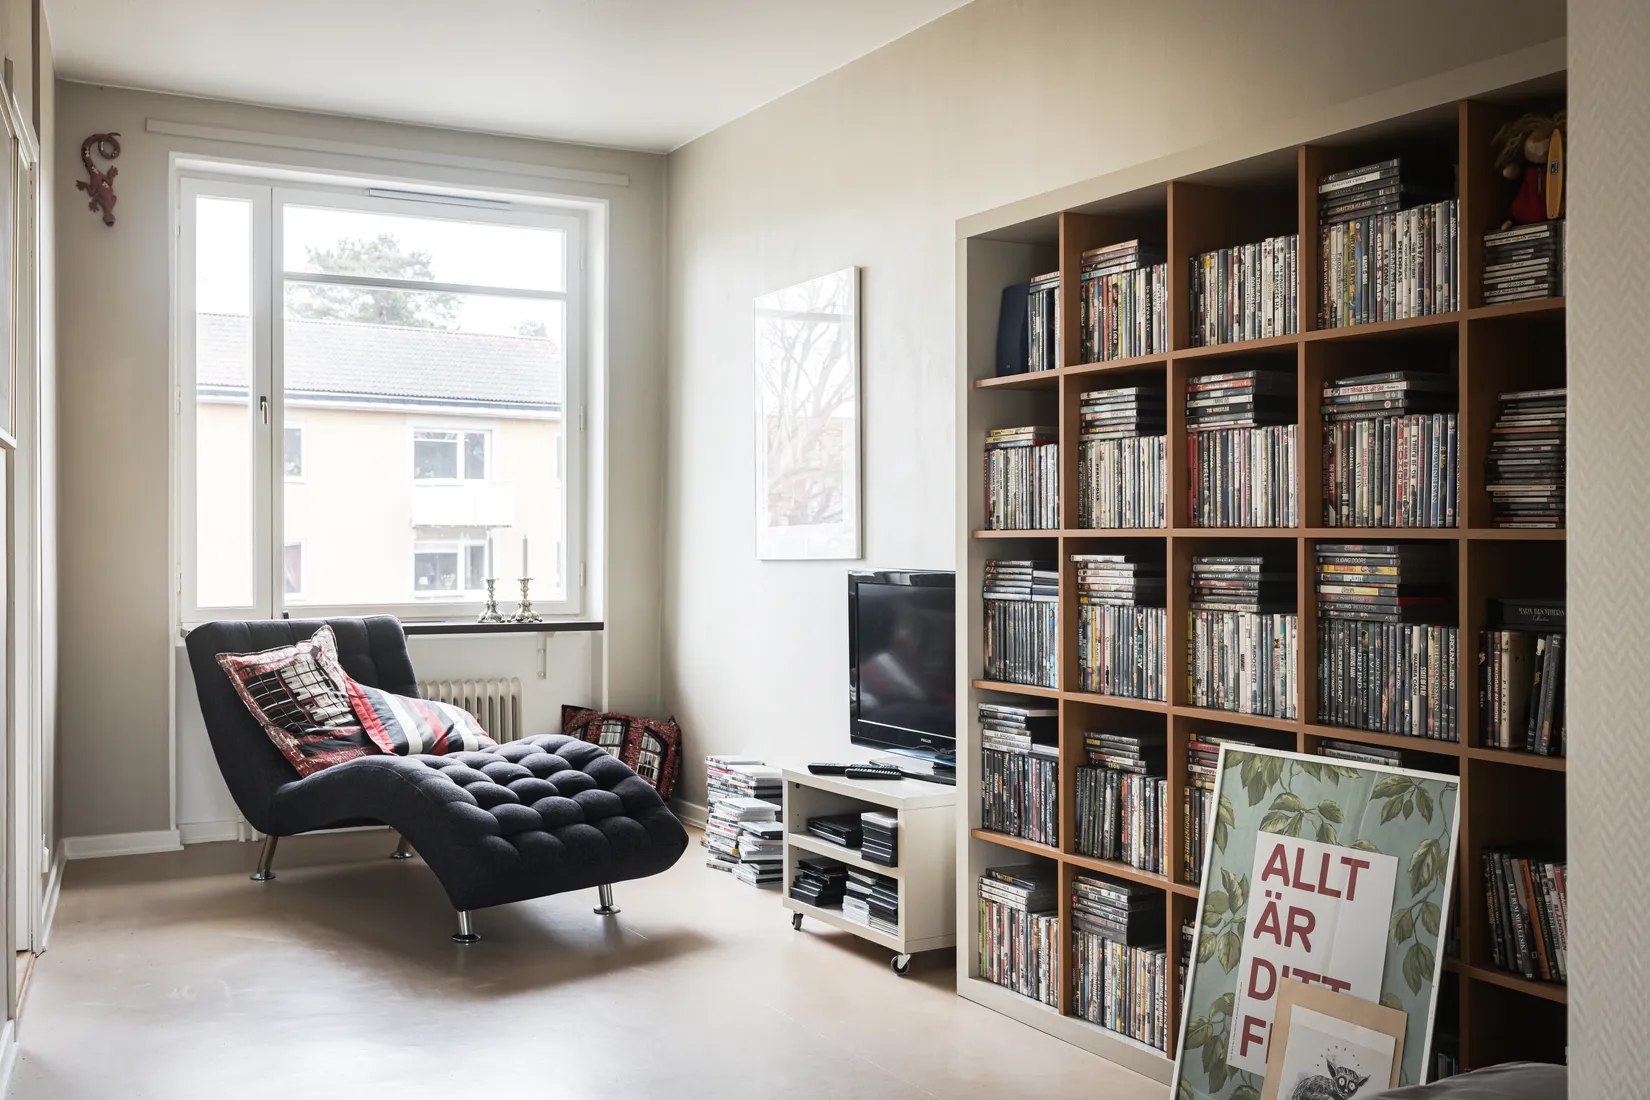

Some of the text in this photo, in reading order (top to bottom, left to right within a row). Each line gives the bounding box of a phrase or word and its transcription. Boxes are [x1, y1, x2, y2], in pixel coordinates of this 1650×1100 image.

[1261, 842, 1370, 902] ALLT
[1253, 889, 1316, 954] ÄR
[1516, 928, 1527, 954] UTSIKT
[1554, 904, 1567, 952] BLÅSNINGEN
